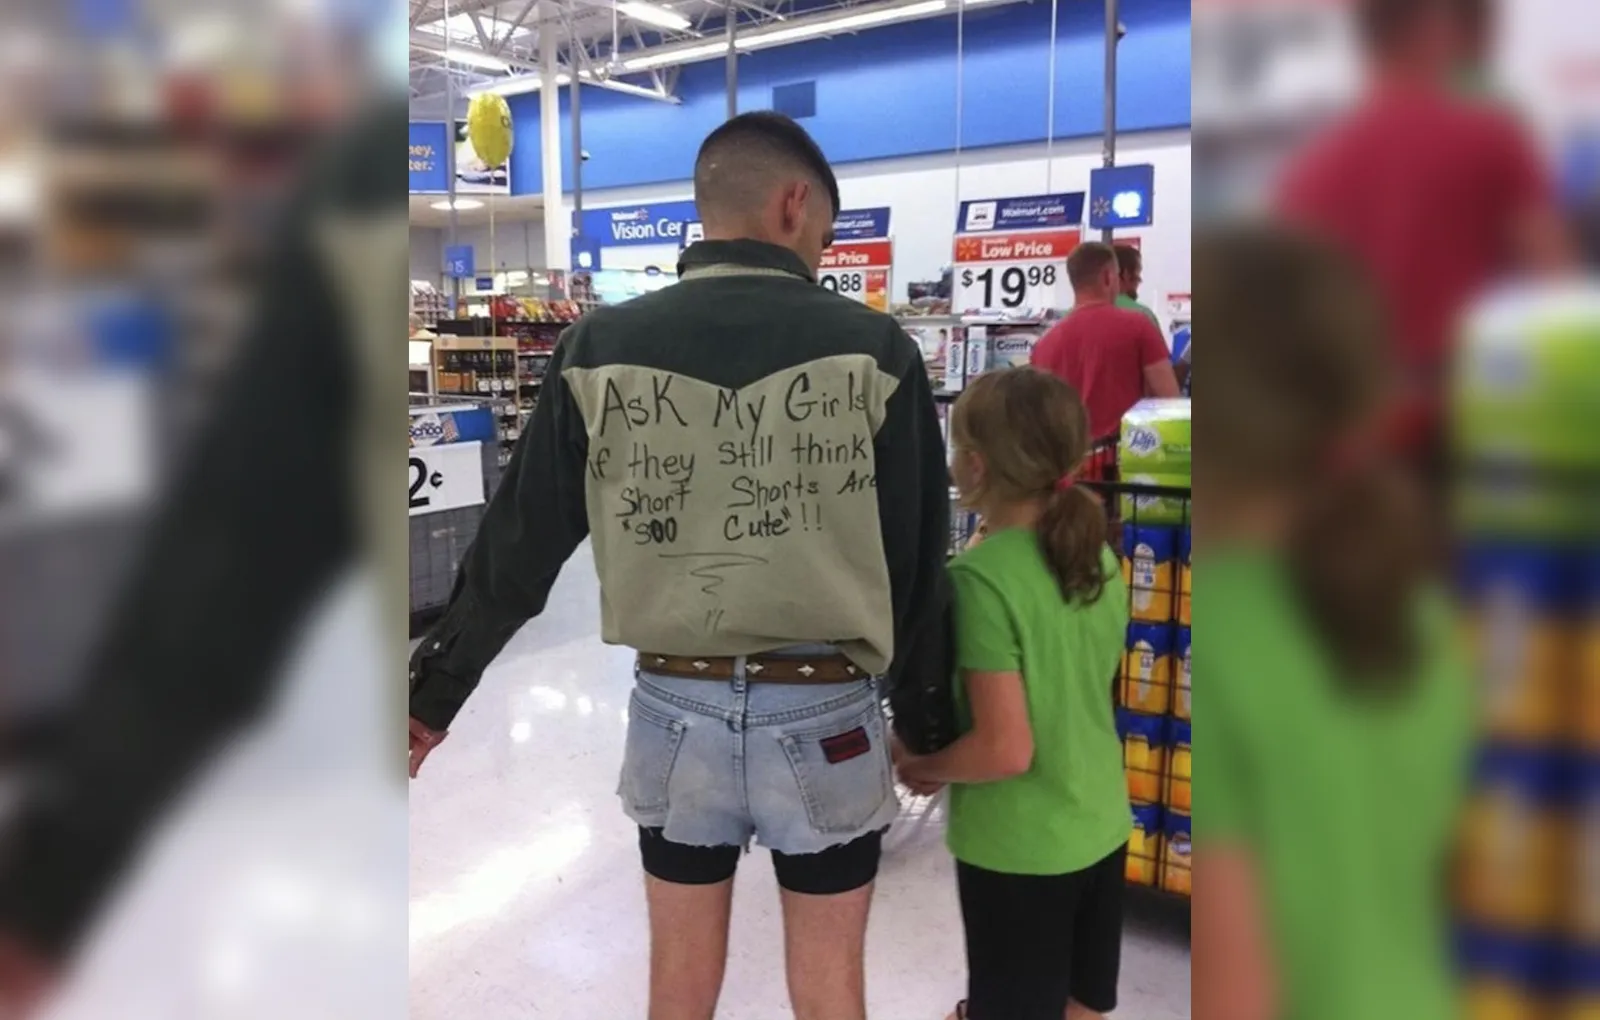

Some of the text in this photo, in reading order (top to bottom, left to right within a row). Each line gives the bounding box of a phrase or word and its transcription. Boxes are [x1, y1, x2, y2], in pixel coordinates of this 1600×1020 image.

[1002, 205, 1065, 217] Walmart.com
[612, 221, 655, 240] Vision
[820, 256, 837, 266] ow
[837, 250, 869, 264] Price
[981, 240, 1053, 258] Low Price
[599, 371, 867, 446] AsK My Girls
[627, 442, 695, 484] they
[791, 432, 868, 465] think
[615, 483, 692, 518] Short
[727, 472, 820, 510] Shorts
